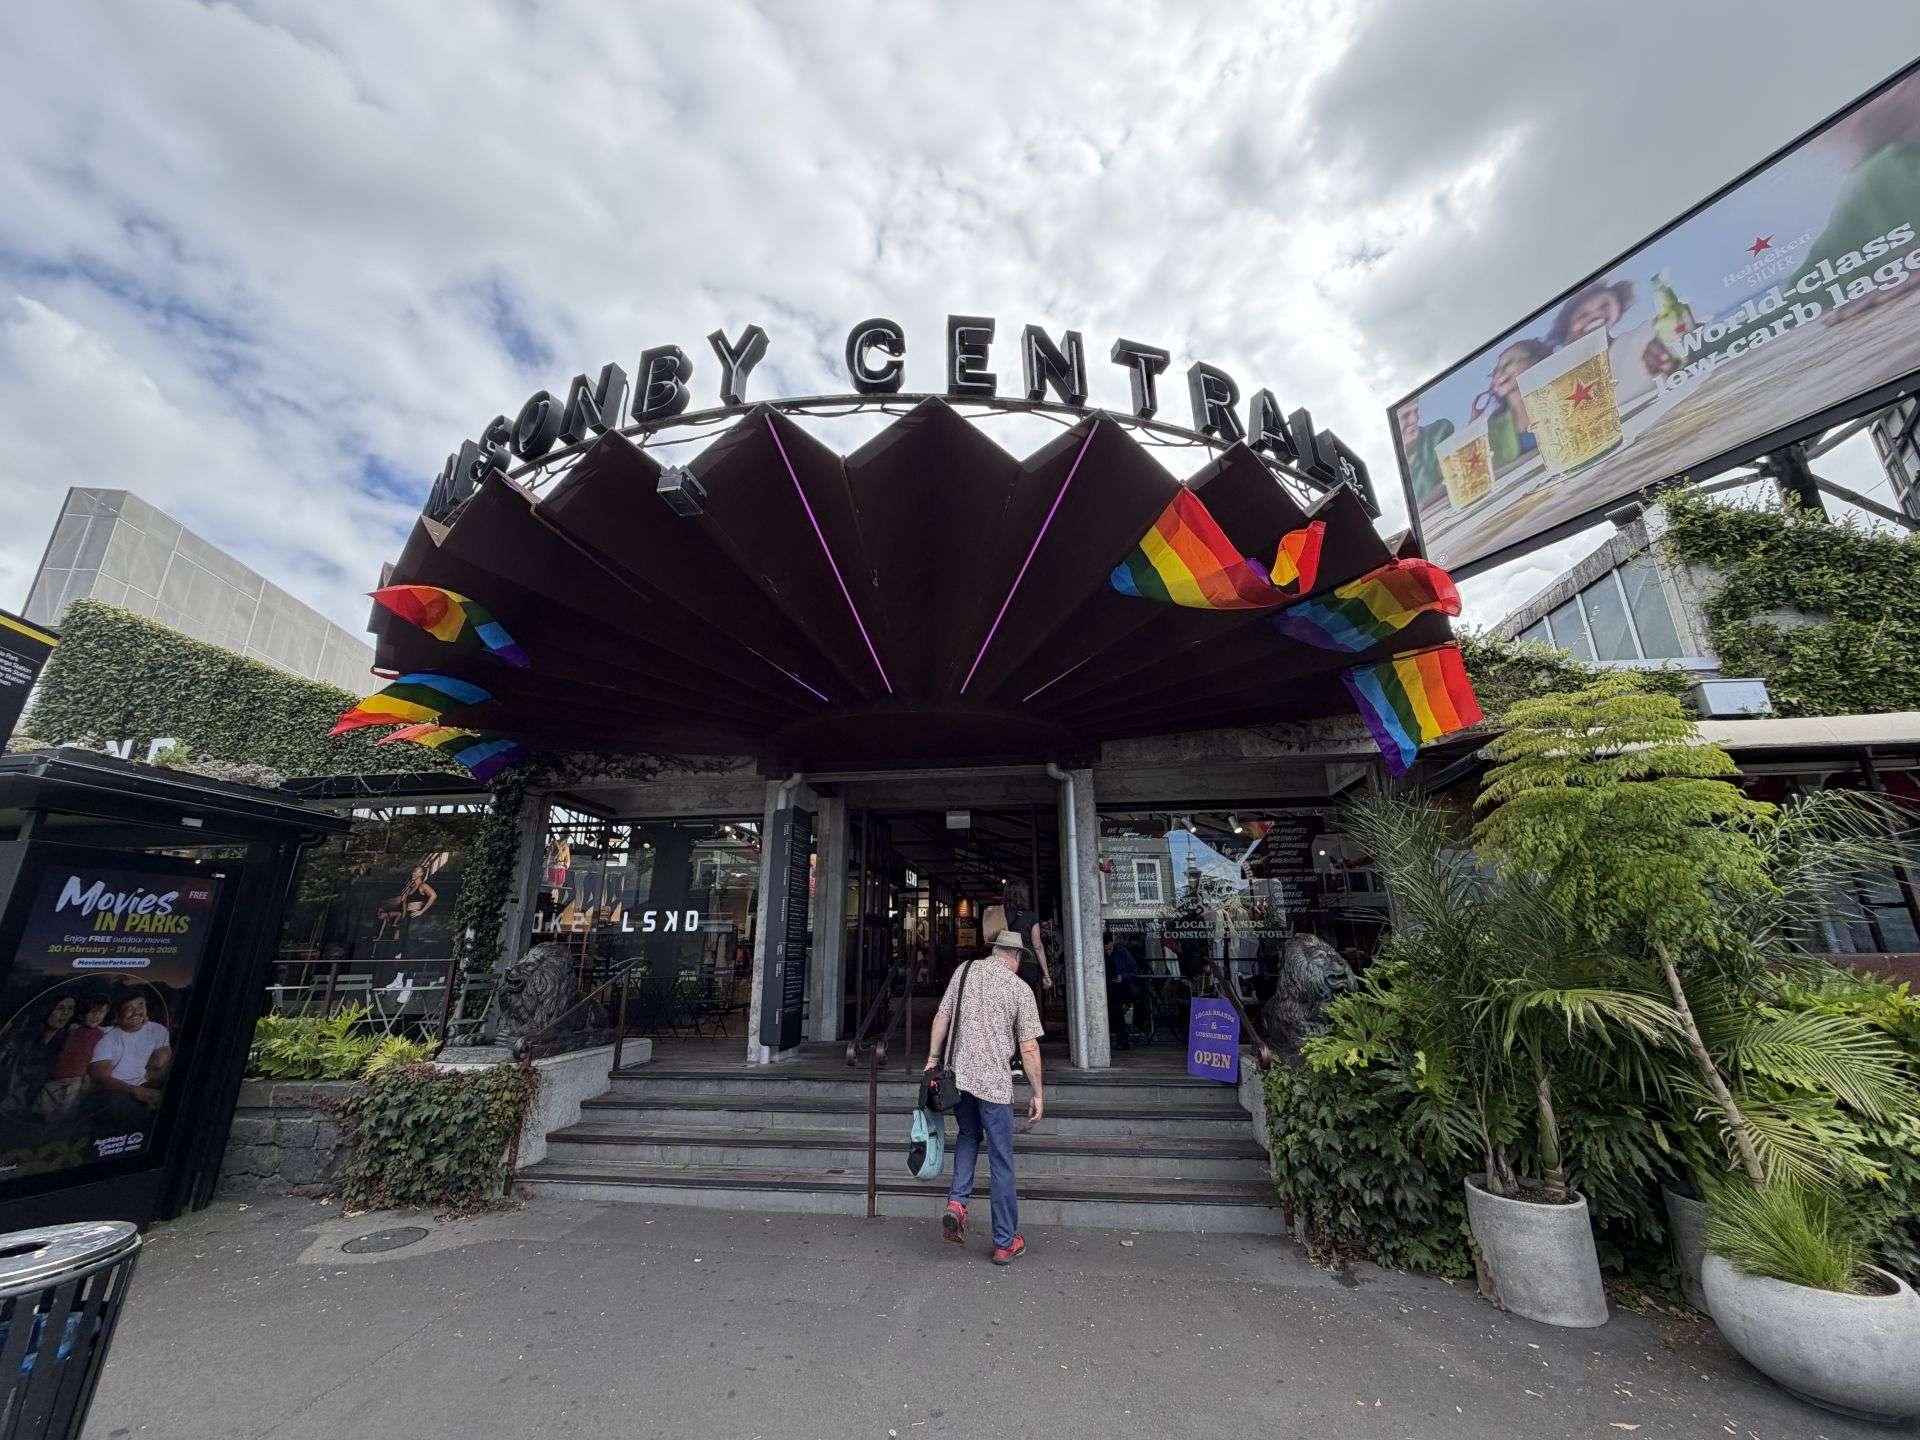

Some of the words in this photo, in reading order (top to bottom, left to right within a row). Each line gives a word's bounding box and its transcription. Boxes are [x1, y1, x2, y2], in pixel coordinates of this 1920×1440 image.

[1748, 255, 1794, 287] SILVER
[1671, 222, 1915, 358] World-class
[1653, 301, 1822, 398] low-carb
[1825, 247, 1920, 310] lage
[845, 314, 1337, 488] CENTRAL
[55, 875, 179, 916] Movies
[188, 890, 209, 900] FREE
[93, 912, 119, 931] IN
[124, 912, 191, 934] PARKS
[1175, 920, 1213, 929] LOCAL
[1217, 920, 1265, 929] RANDS
[63, 934, 88, 945] Enjoy
[88, 935, 113, 943] FREE
[112, 936, 144, 945] outdoor
[1164, 930, 1249, 939] CONSIGNENT
[63, 945, 108, 955] February
[127, 946, 155, 954] March
[1211, 1021, 1218, 1030] &
[1193, 1049, 1232, 1069] OPEN
